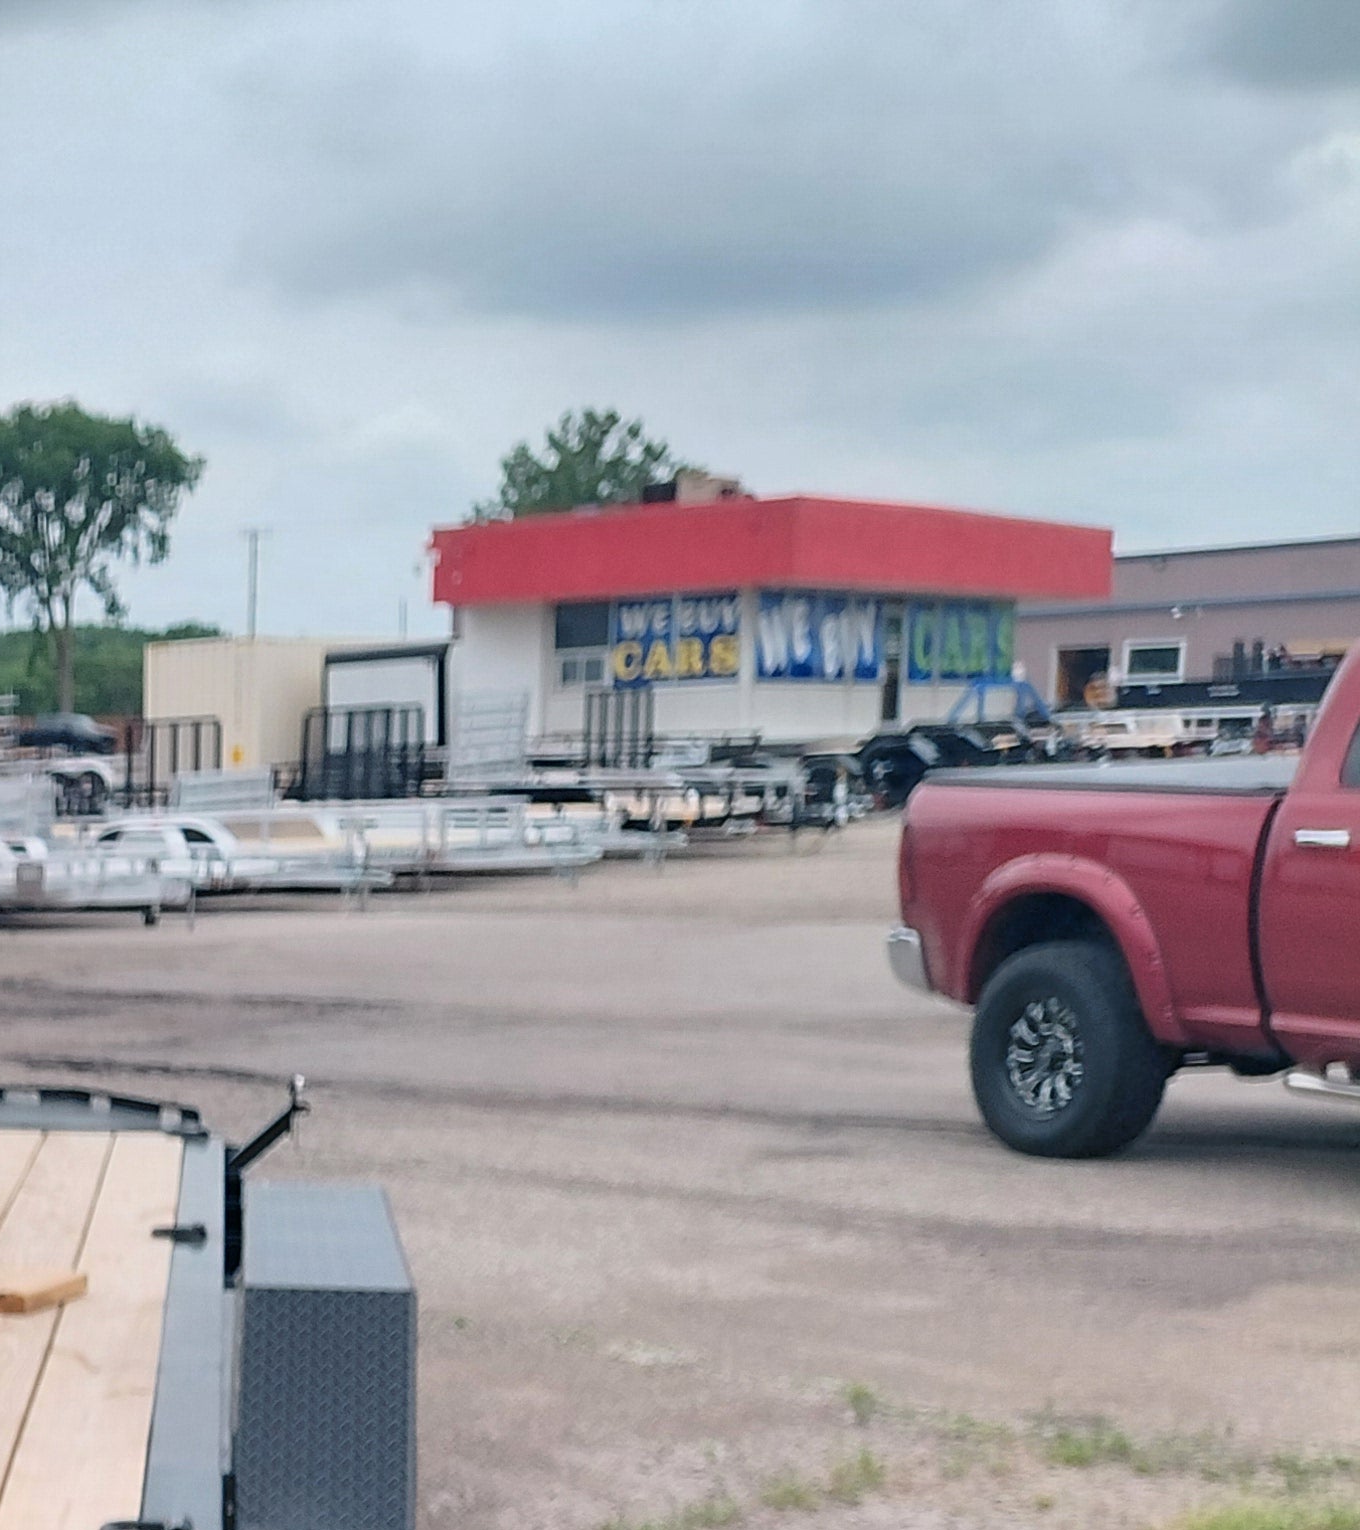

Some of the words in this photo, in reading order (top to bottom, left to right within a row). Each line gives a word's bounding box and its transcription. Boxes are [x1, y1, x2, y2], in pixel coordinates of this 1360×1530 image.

[620, 603, 671, 638] WE
[678, 598, 741, 635] BUY
[759, 598, 811, 676] WE
[913, 608, 1015, 674] CARS
[612, 635, 740, 681] CARS
